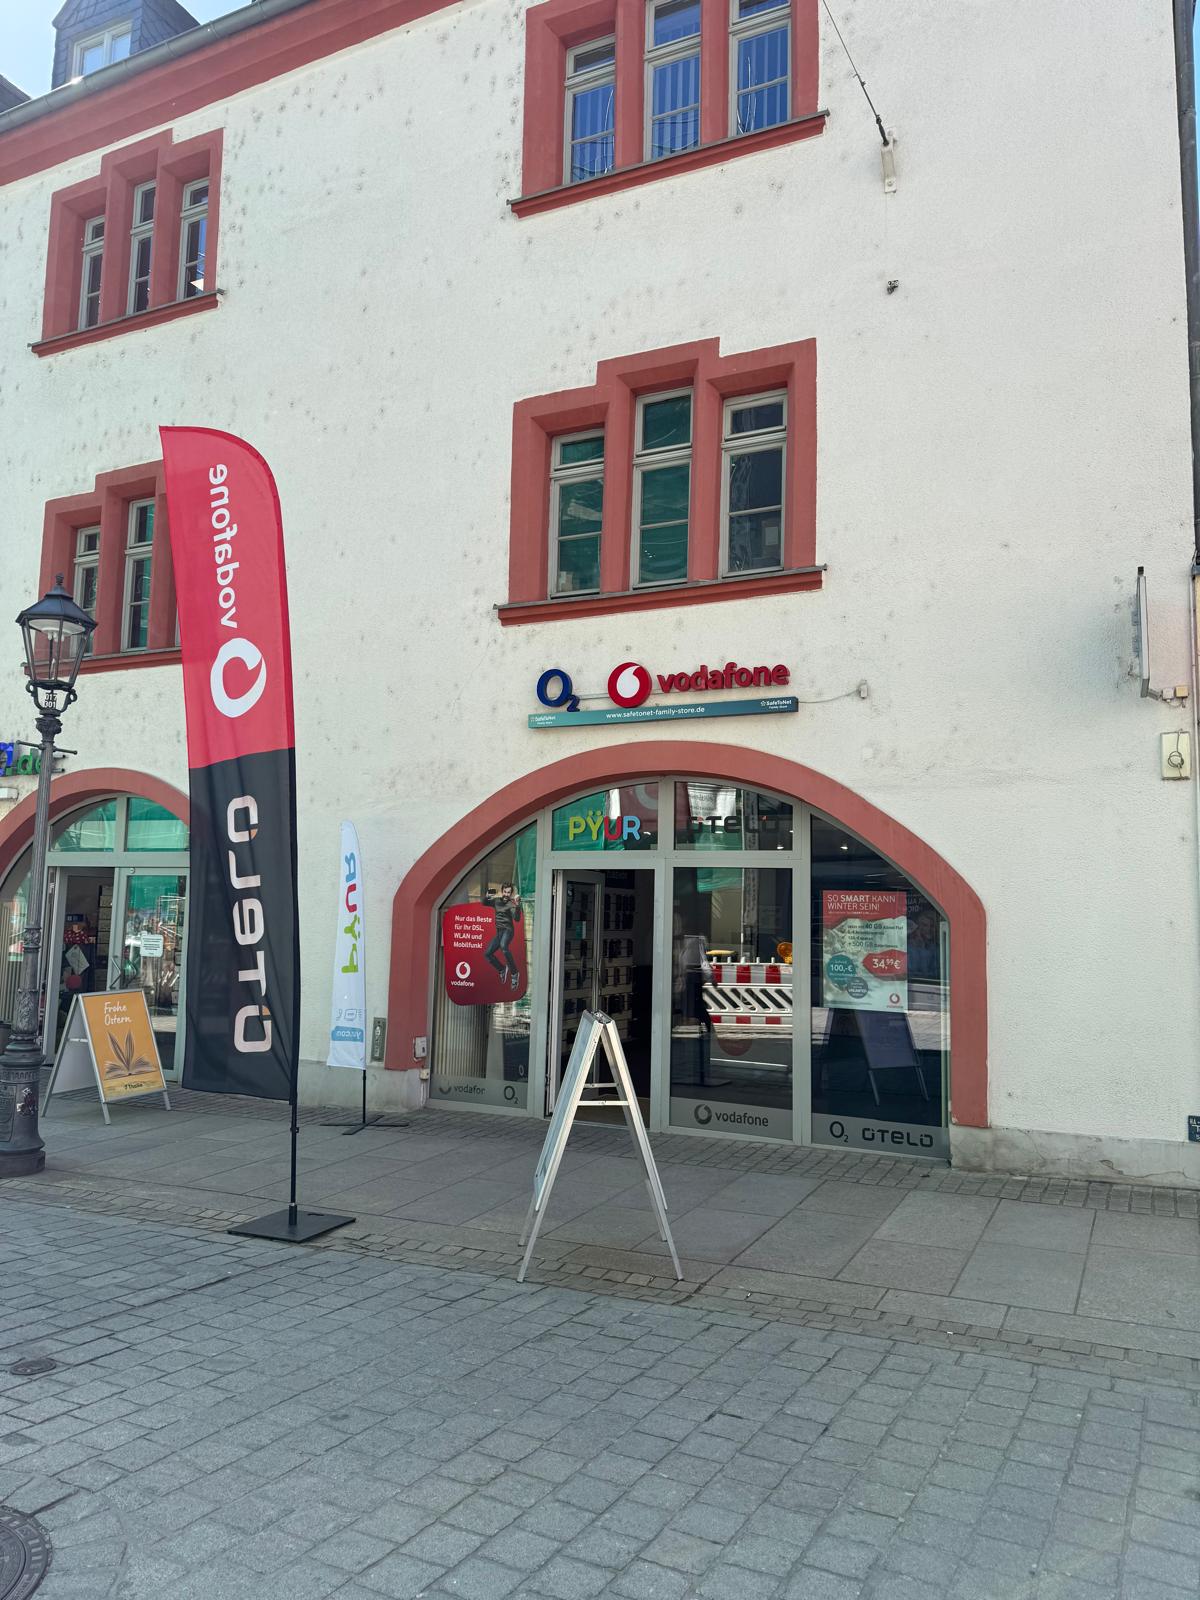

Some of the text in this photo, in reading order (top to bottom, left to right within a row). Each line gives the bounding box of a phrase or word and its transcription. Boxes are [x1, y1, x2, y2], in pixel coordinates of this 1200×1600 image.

[656, 661, 791, 694] vodafone
[605, 705, 705, 720] www.safetonet-family-store.de
[827, 894, 896, 903] SO SMART KANN
[827, 902, 880, 911] WINTER SEIN!
[454, 914, 465, 922] Nur
[453, 932, 470, 940] WLAN
[453, 941, 483, 949] Mobilfunk!
[104, 1000, 128, 1014] Frohe
[104, 1014, 132, 1026] Ostern
[715, 1111, 769, 1127] vodafone
[829, 1120, 849, 1143] O2
